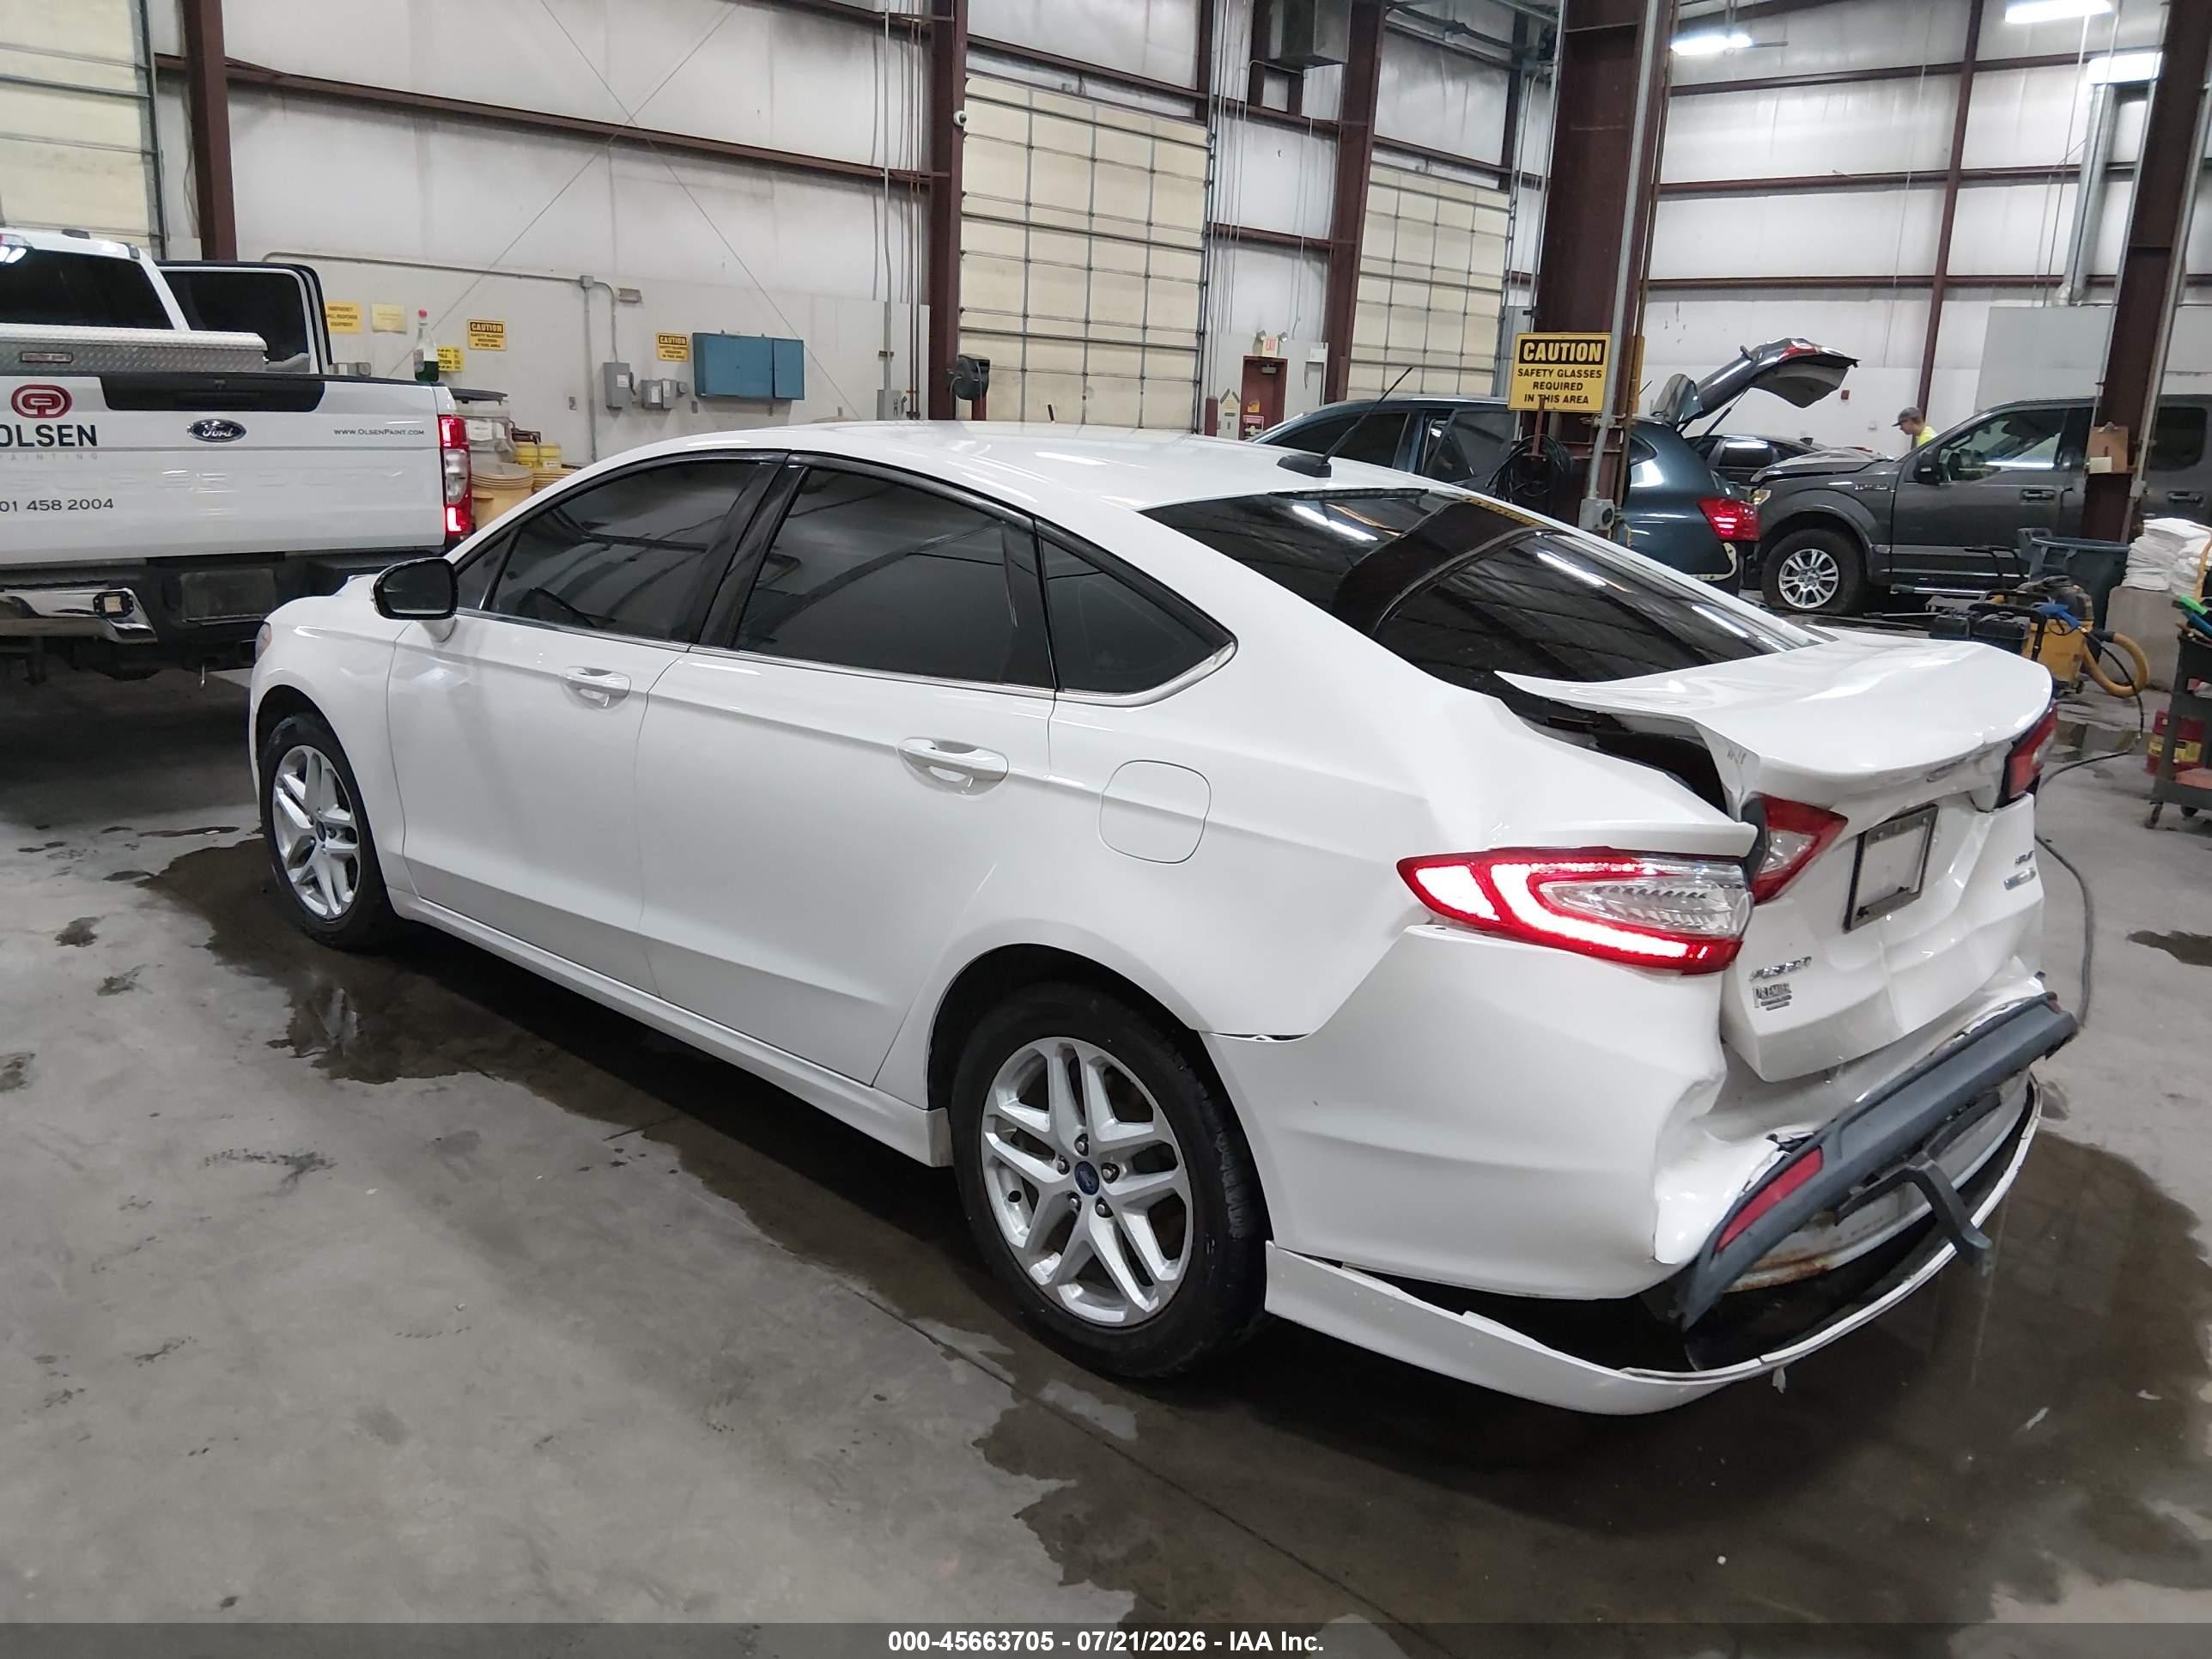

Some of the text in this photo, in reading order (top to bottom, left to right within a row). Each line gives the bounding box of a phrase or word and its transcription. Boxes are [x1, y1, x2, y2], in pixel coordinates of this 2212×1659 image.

[471, 323, 503, 332] CAUTION
[1522, 342, 1602, 362] CAUTION
[1517, 368, 1602, 379] SAFETY GLASSES
[1532, 380, 1583, 392] REQUIRED
[1524, 393, 1589, 404] IN THIS AREA
[0, 423, 98, 447] OLSEN
[202, 424, 234, 437] Ford
[0, 498, 114, 513] 01 458 2004
